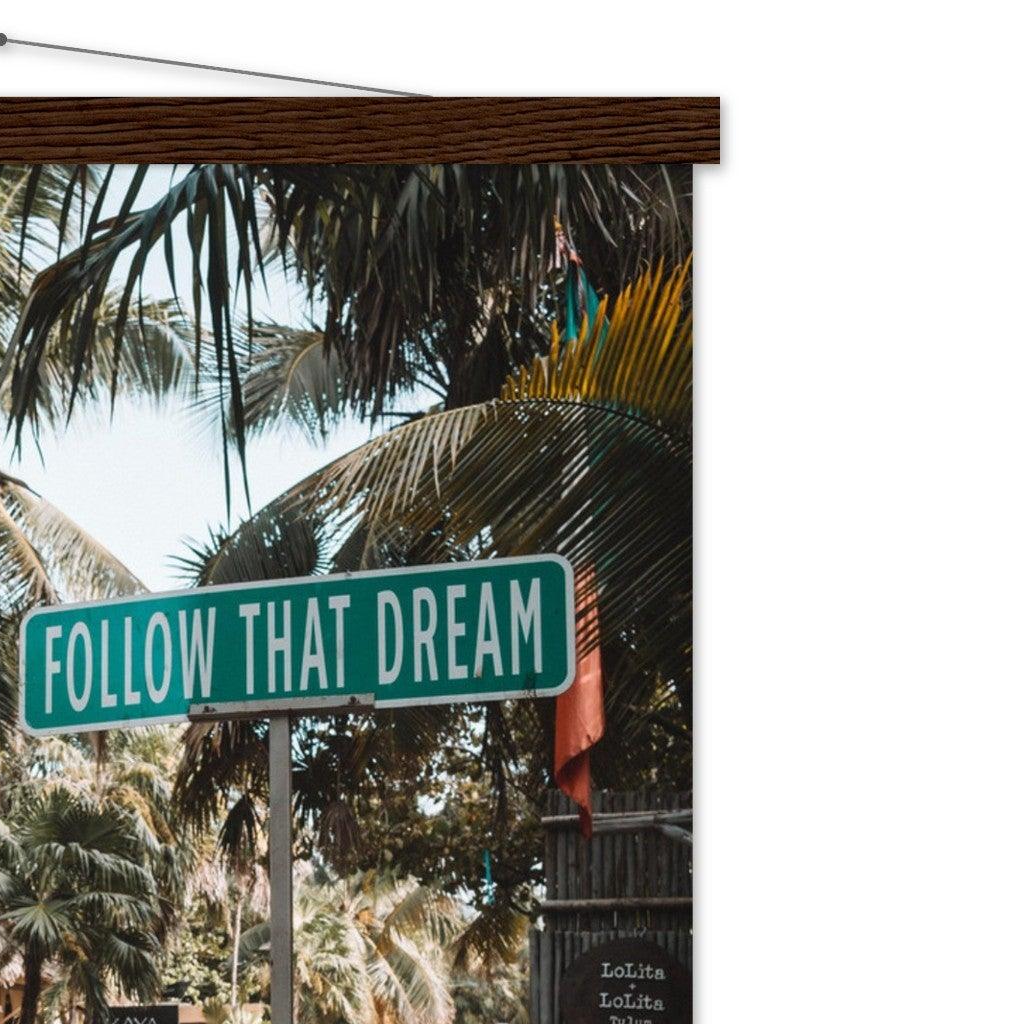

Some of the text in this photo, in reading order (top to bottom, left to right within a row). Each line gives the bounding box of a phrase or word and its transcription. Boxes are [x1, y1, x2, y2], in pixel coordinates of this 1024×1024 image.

[45, 577, 544, 715] FOLLOW THAT DREAM
[601, 962, 666, 980] LoLita
[599, 992, 666, 1011] LoLita
